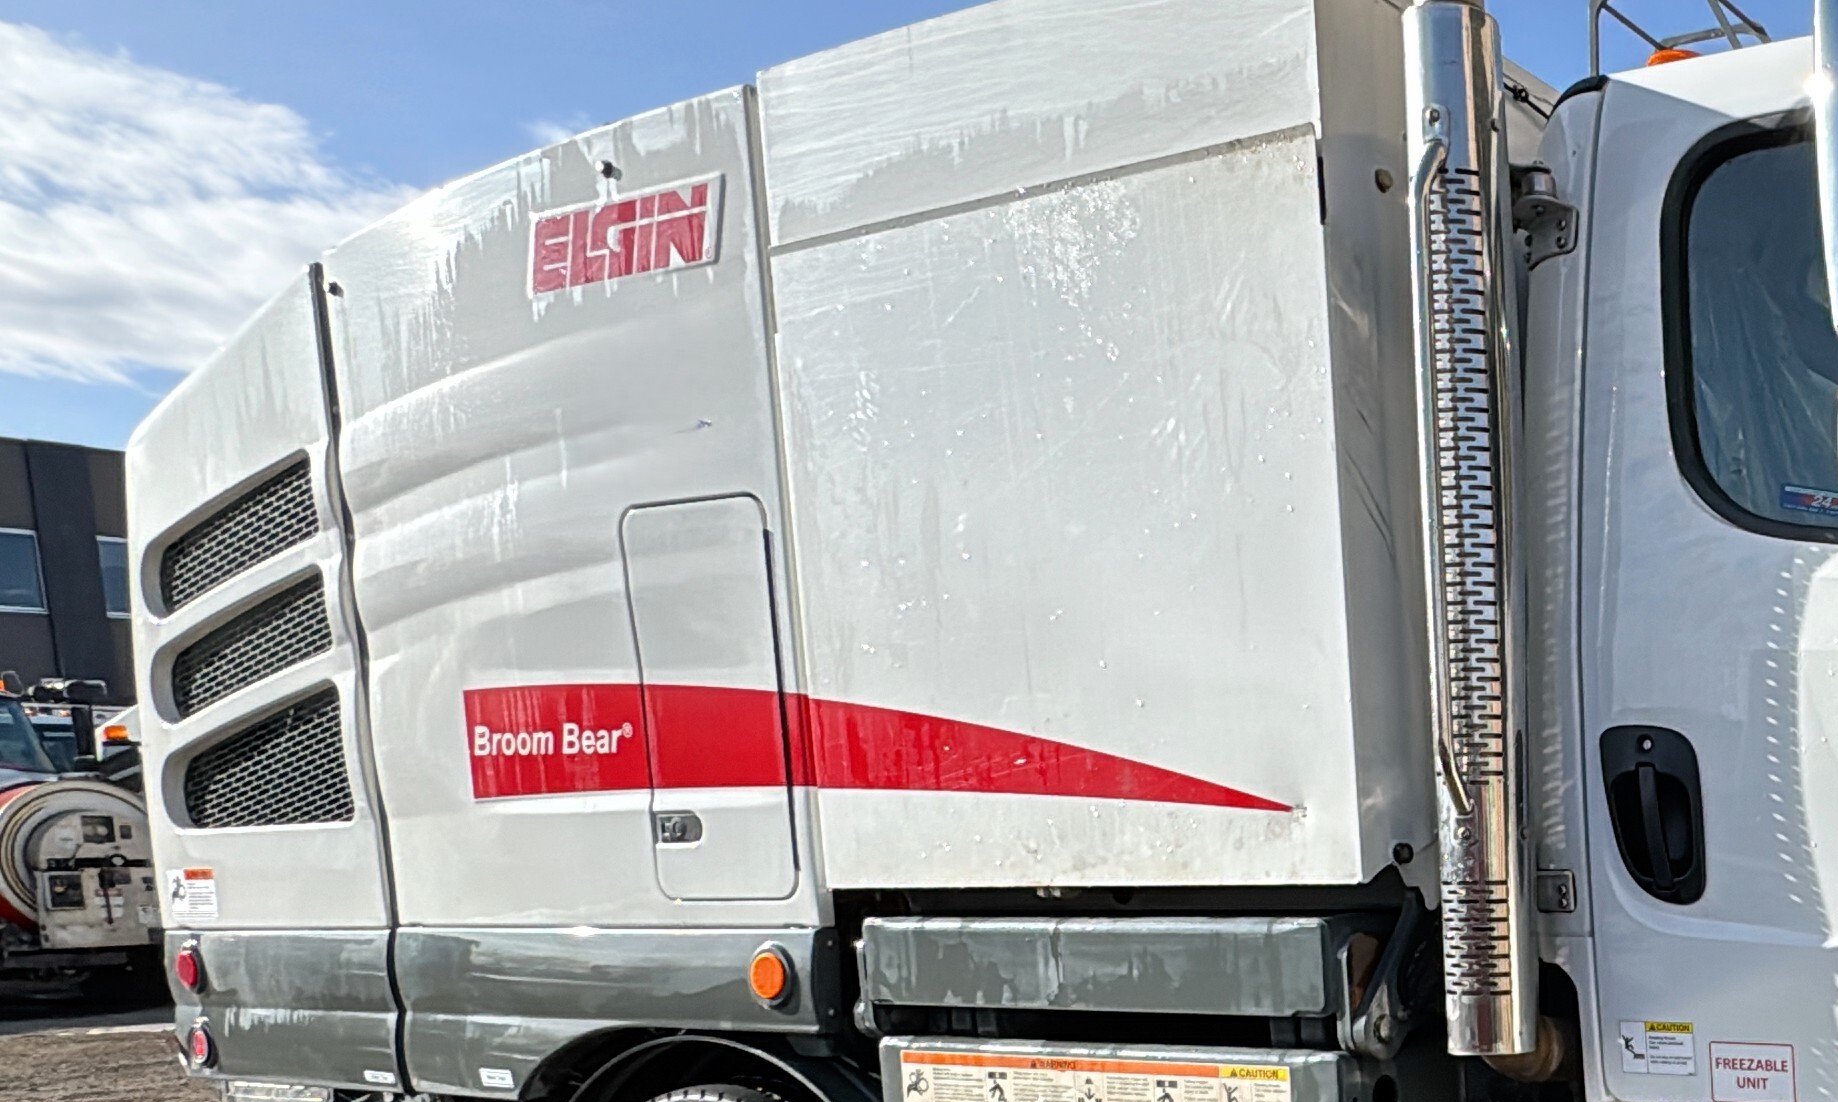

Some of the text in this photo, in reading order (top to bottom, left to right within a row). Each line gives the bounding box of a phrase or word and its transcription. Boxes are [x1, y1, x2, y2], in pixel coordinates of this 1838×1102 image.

[533, 182, 708, 294] ELGIN
[474, 725, 554, 756] Broom
[1657, 1023, 1690, 1032] CAUTION
[1715, 1057, 1789, 1072] FREEZABLE
[1238, 1068, 1278, 1079] CAUTION
[1737, 1077, 1769, 1090] UNIT
